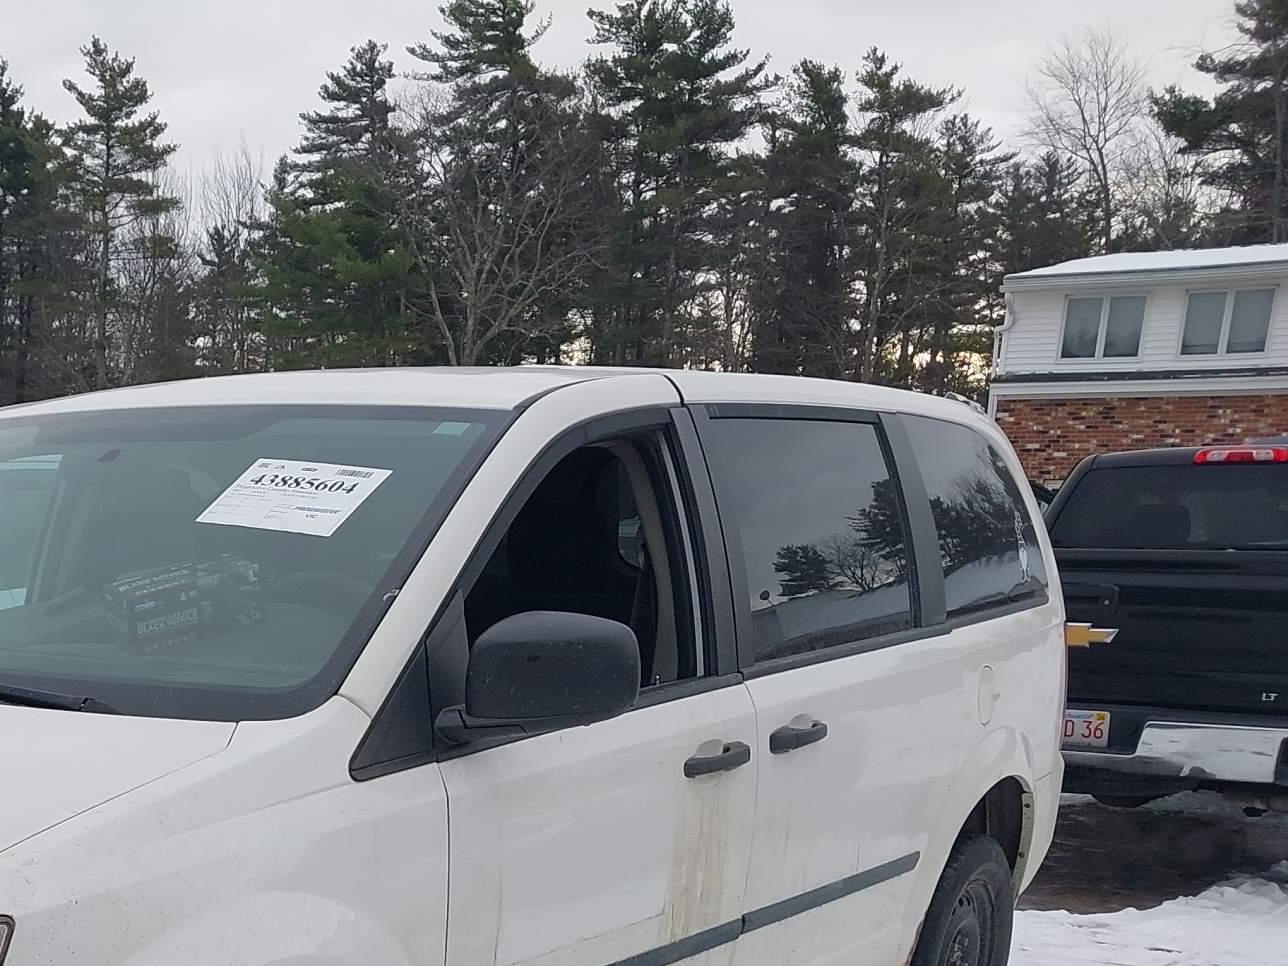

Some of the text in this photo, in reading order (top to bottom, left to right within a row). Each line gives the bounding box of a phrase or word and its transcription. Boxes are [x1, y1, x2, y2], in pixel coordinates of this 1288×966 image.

[250, 473, 360, 494] 43885604
[1263, 692, 1279, 702] LT
[1081, 720, 1105, 740] 36
